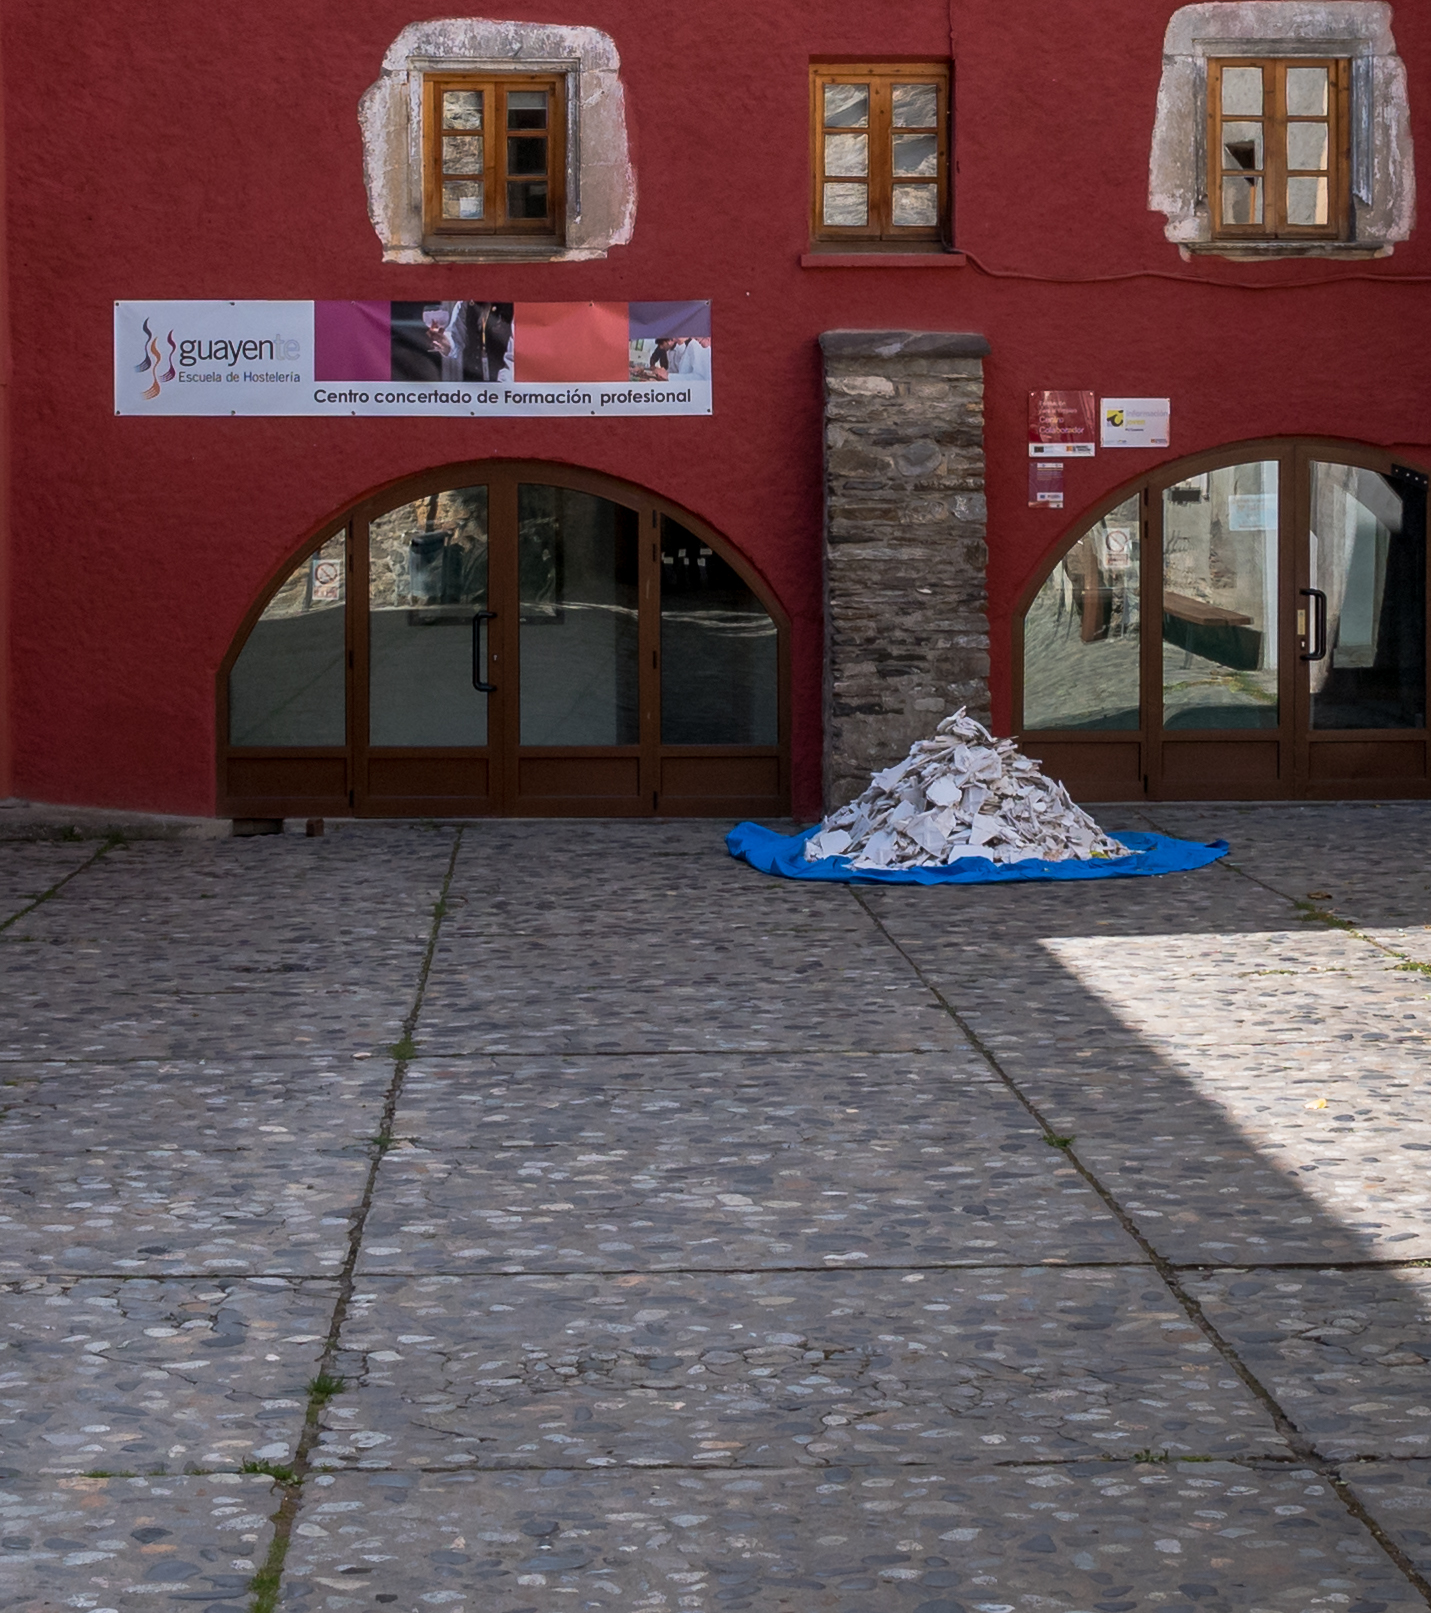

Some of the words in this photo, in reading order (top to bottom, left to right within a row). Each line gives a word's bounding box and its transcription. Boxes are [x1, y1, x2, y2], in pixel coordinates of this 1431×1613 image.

[179, 333, 300, 367] guayente
[178, 371, 222, 383] Escuela
[225, 371, 240, 383] de
[243, 371, 301, 383] Hostelería
[313, 389, 369, 404] Centro
[374, 389, 472, 404] concertado
[476, 390, 499, 404] de
[504, 388, 592, 404] Formación
[600, 388, 692, 407] profesional
